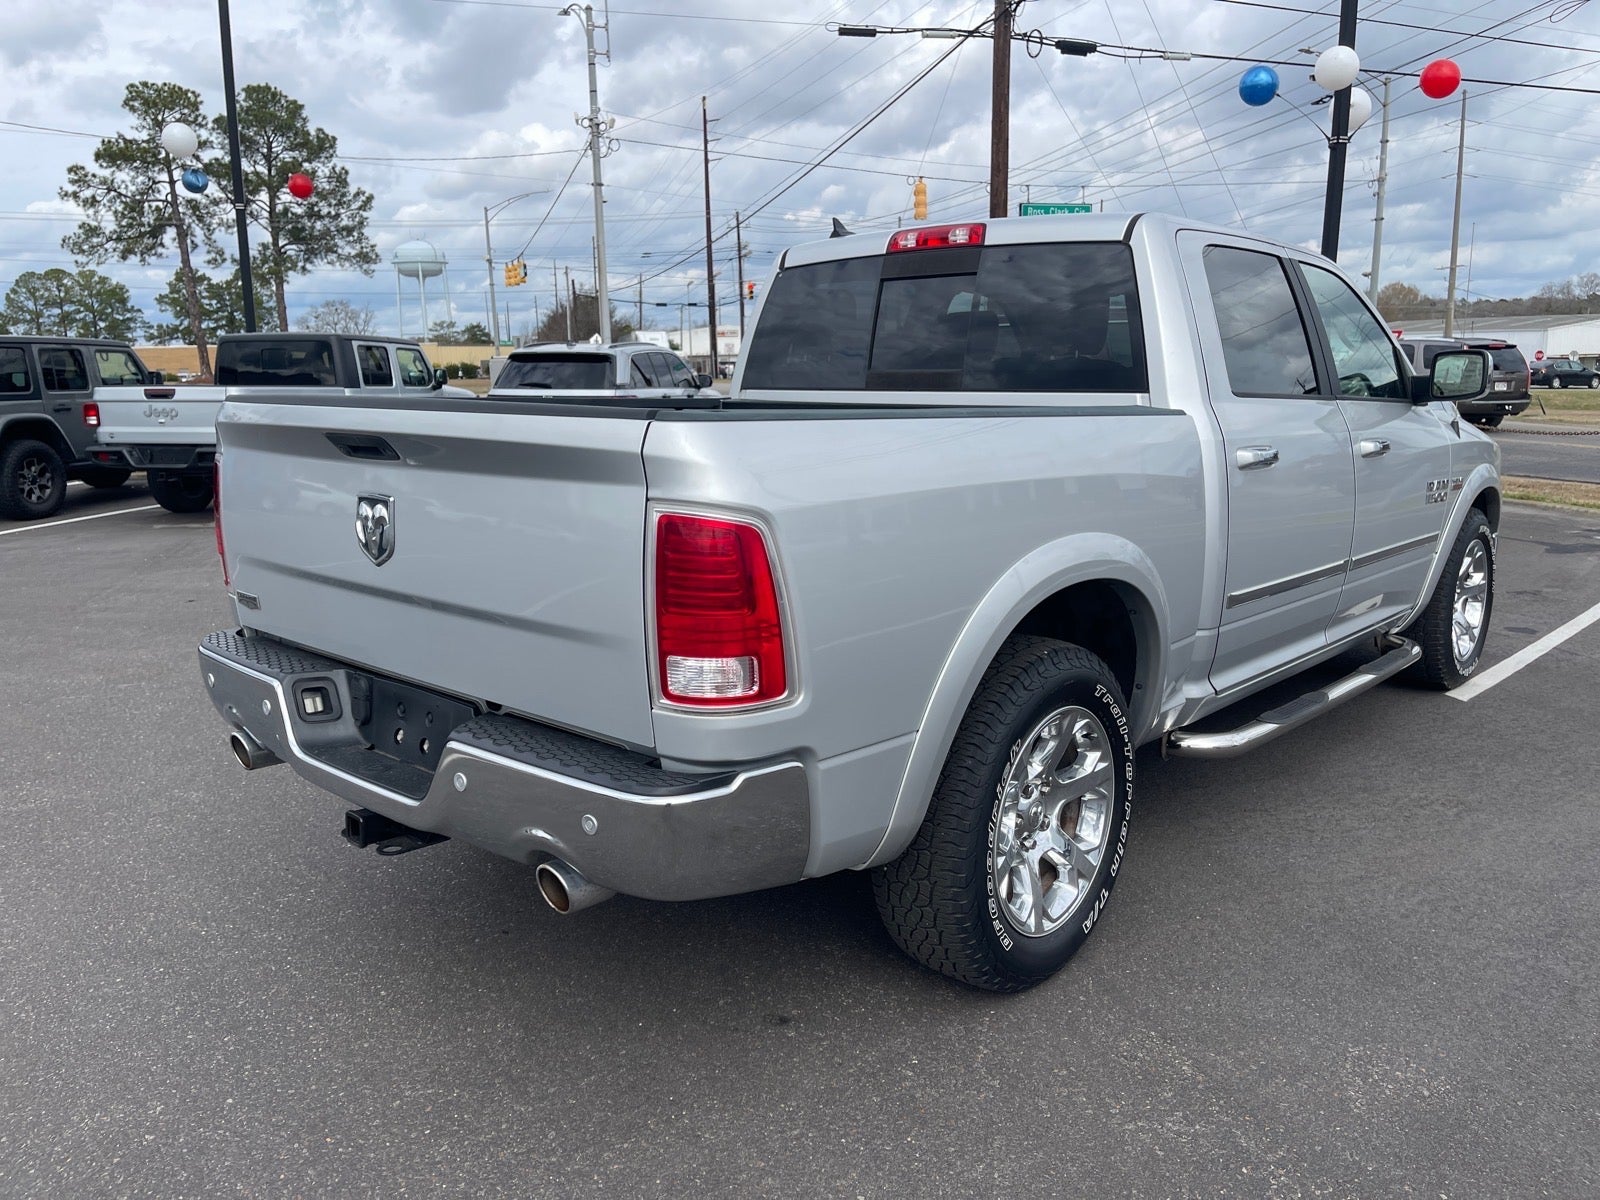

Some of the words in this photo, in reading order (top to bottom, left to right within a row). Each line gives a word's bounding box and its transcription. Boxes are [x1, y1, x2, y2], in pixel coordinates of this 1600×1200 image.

[1027, 206, 1045, 216] Ross
[1049, 207, 1069, 215] Clark
[143, 404, 179, 420] Jeep
[1082, 888, 1109, 934] T/A
